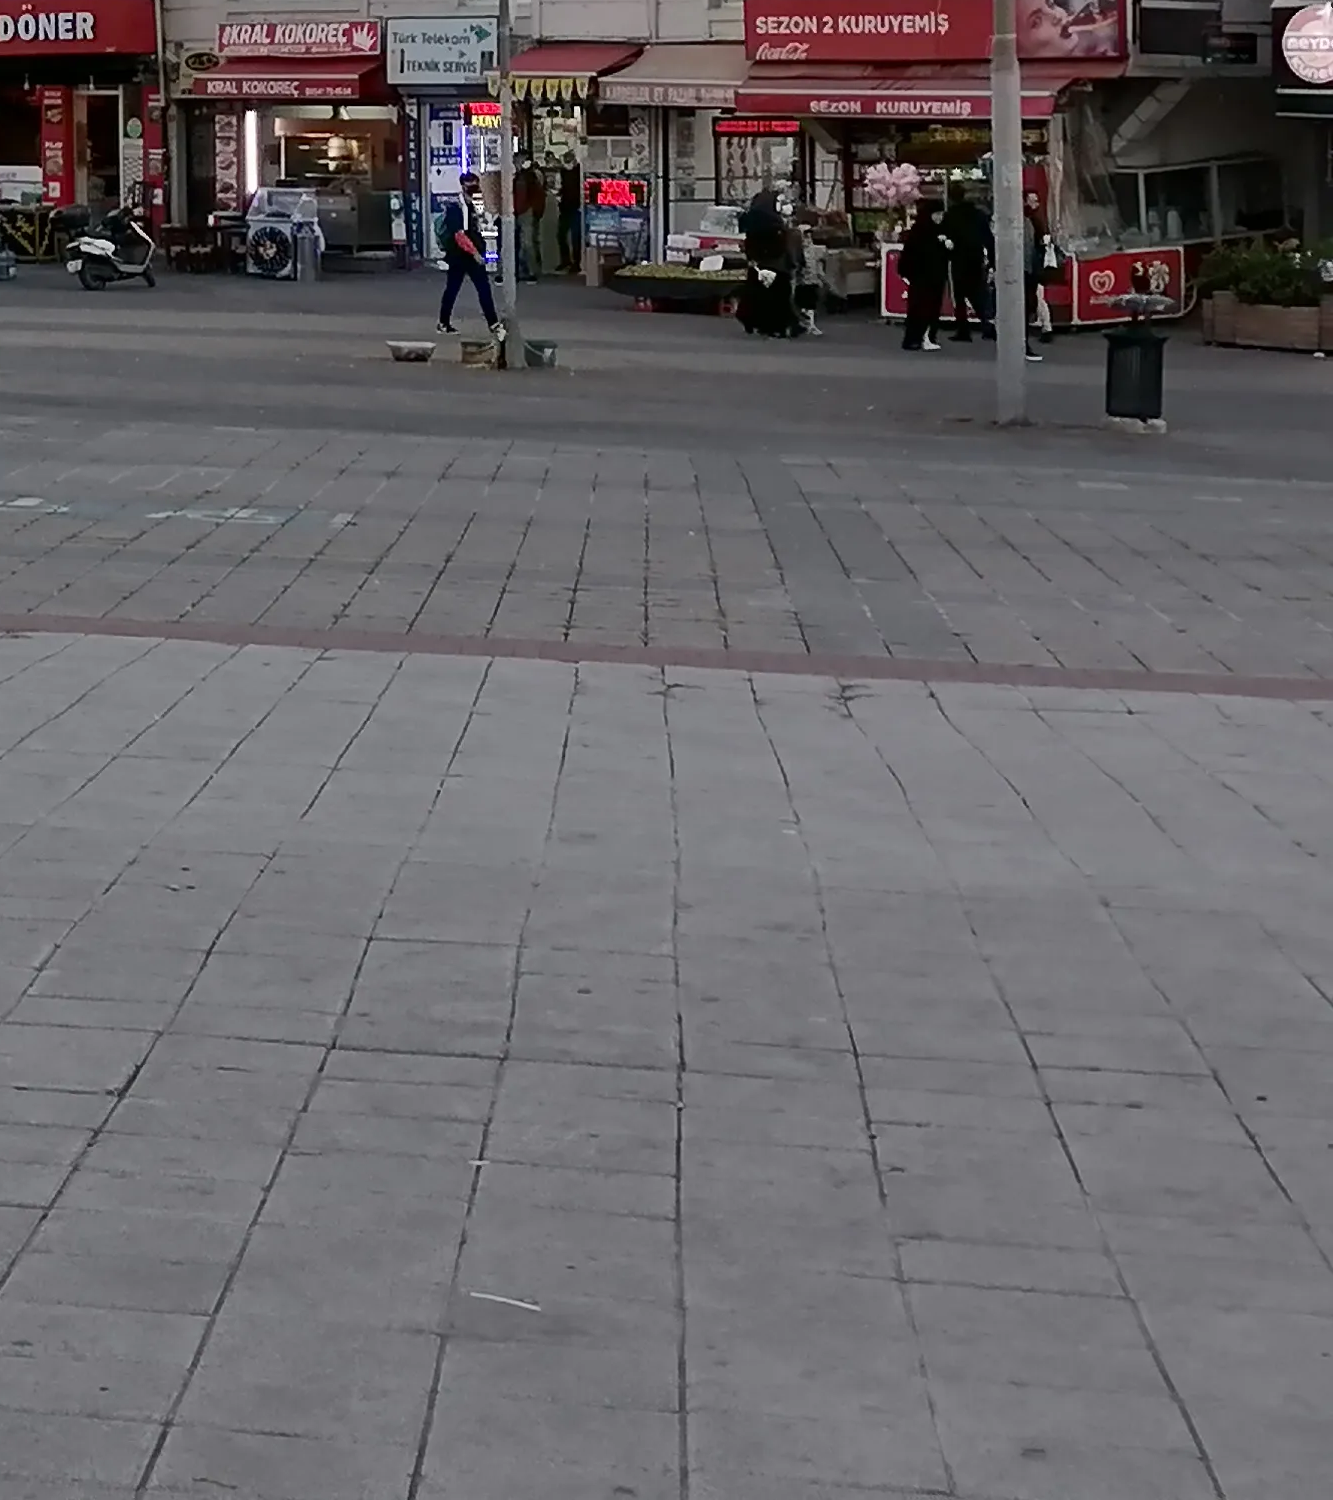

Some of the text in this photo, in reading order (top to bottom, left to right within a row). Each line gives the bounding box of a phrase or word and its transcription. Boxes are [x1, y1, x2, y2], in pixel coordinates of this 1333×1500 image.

[756, 12, 949, 35] SEZON 2 KURUYEMİŞ
[230, 23, 351, 47] KRAL KOKOREÇ
[392, 32, 471, 45] Türk Telekom
[406, 58, 477, 73] TEKNİK SERVİS
[207, 81, 238, 95] KRAL
[242, 81, 300, 97] KOKOREÇ
[810, 98, 971, 116] SEZON KURUYEMİŞ
